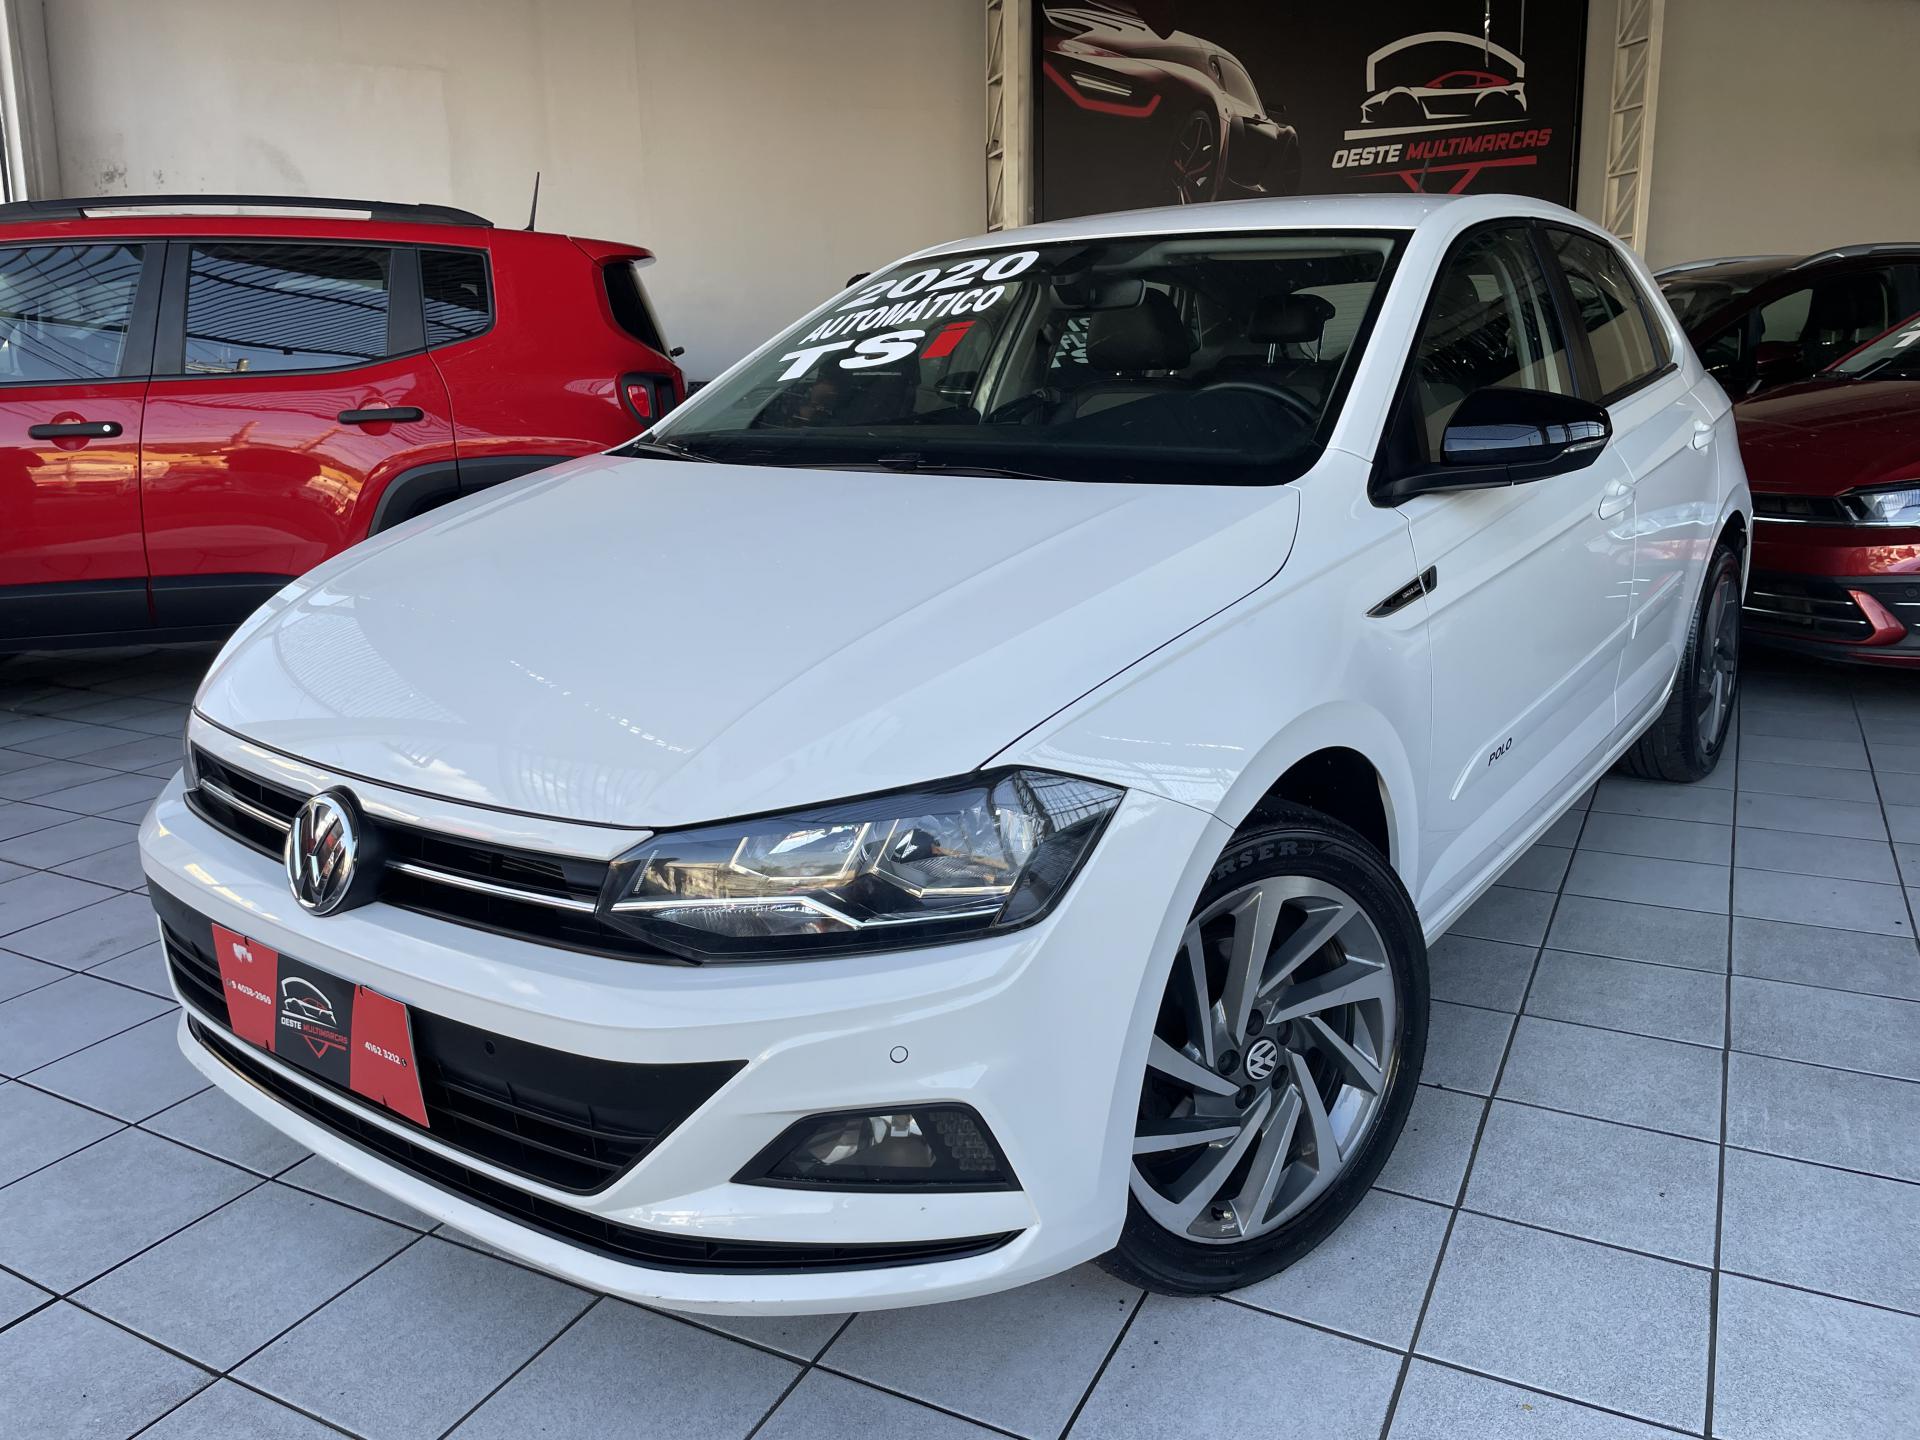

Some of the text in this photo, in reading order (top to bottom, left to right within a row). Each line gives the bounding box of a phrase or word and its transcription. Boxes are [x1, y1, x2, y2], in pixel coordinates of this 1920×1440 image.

[1331, 128, 1553, 169] OESTE MULTIMARCAS
[836, 250, 1040, 312] 2020
[798, 285, 1006, 346] AUTOMÁTICO
[1488, 737, 1513, 767] POLO
[281, 1016, 349, 1045] OESTE MULTIMARCAS
